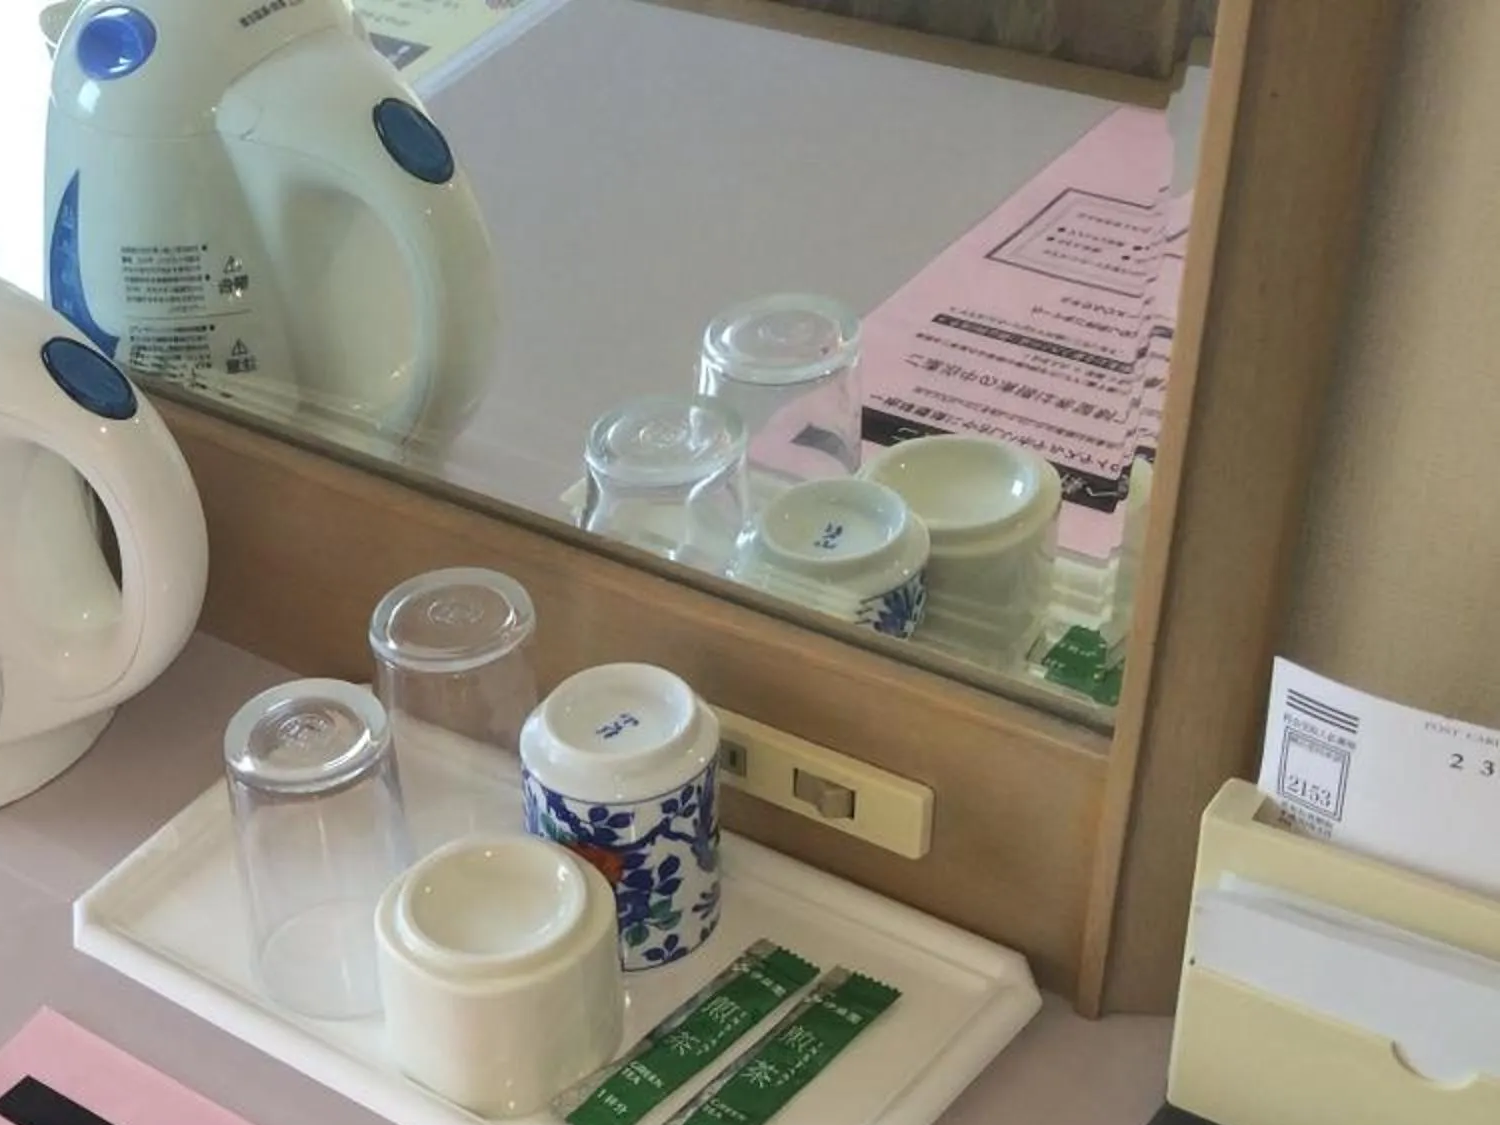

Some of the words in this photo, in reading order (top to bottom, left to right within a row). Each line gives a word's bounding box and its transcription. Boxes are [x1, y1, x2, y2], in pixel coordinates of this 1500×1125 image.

[1288, 775, 1332, 808] 2153
[621, 1068, 641, 1086] TEA
[628, 1061, 664, 1088] GREEN
